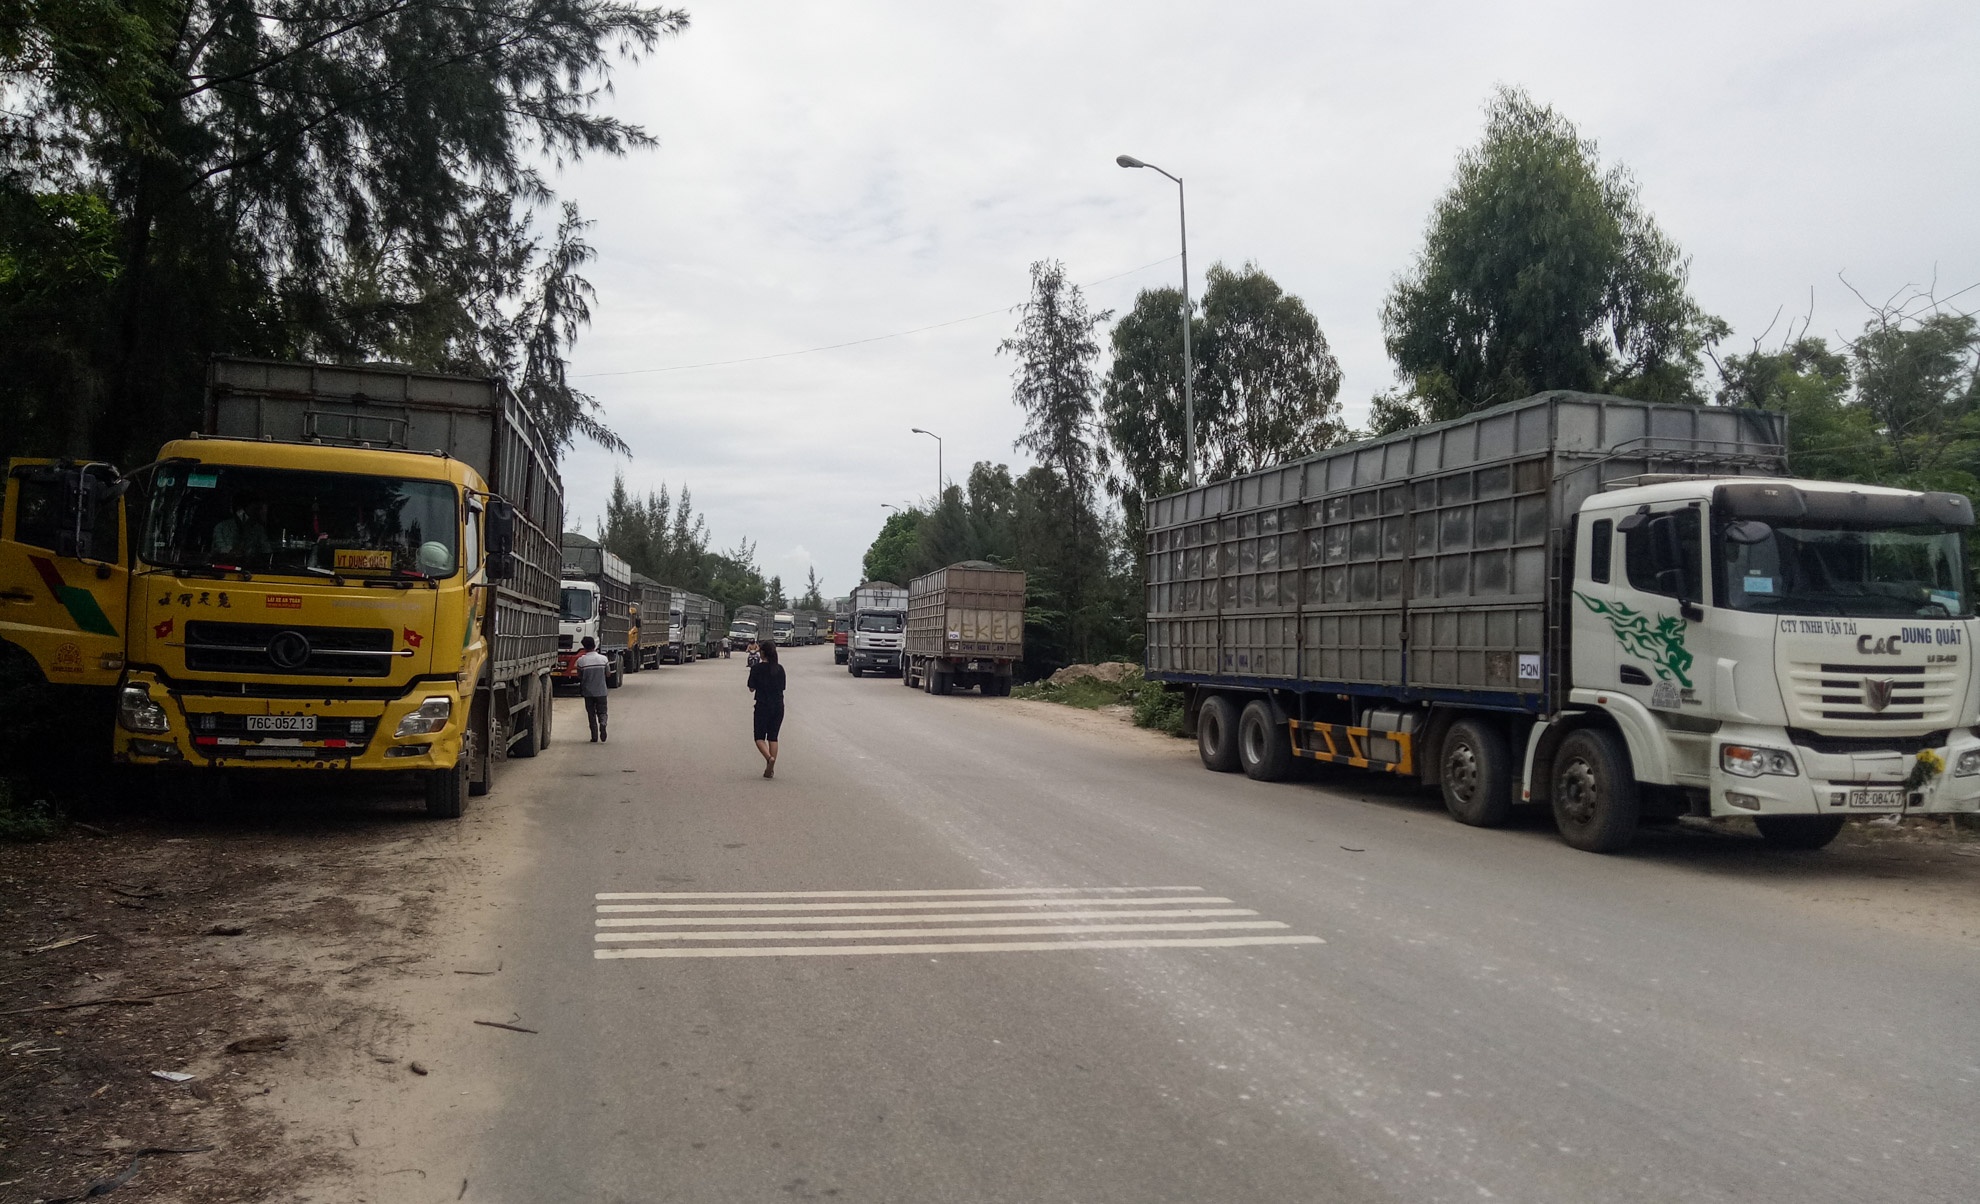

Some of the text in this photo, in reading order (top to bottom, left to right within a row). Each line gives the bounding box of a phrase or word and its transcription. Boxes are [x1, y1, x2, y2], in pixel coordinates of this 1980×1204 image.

[1780, 620, 1797, 633] CTY
[1800, 620, 1823, 634] TNHH
[1902, 627, 1932, 644] DUNG
[1857, 634, 1901, 655] C&C
[1521, 663, 1539, 677] PQN
